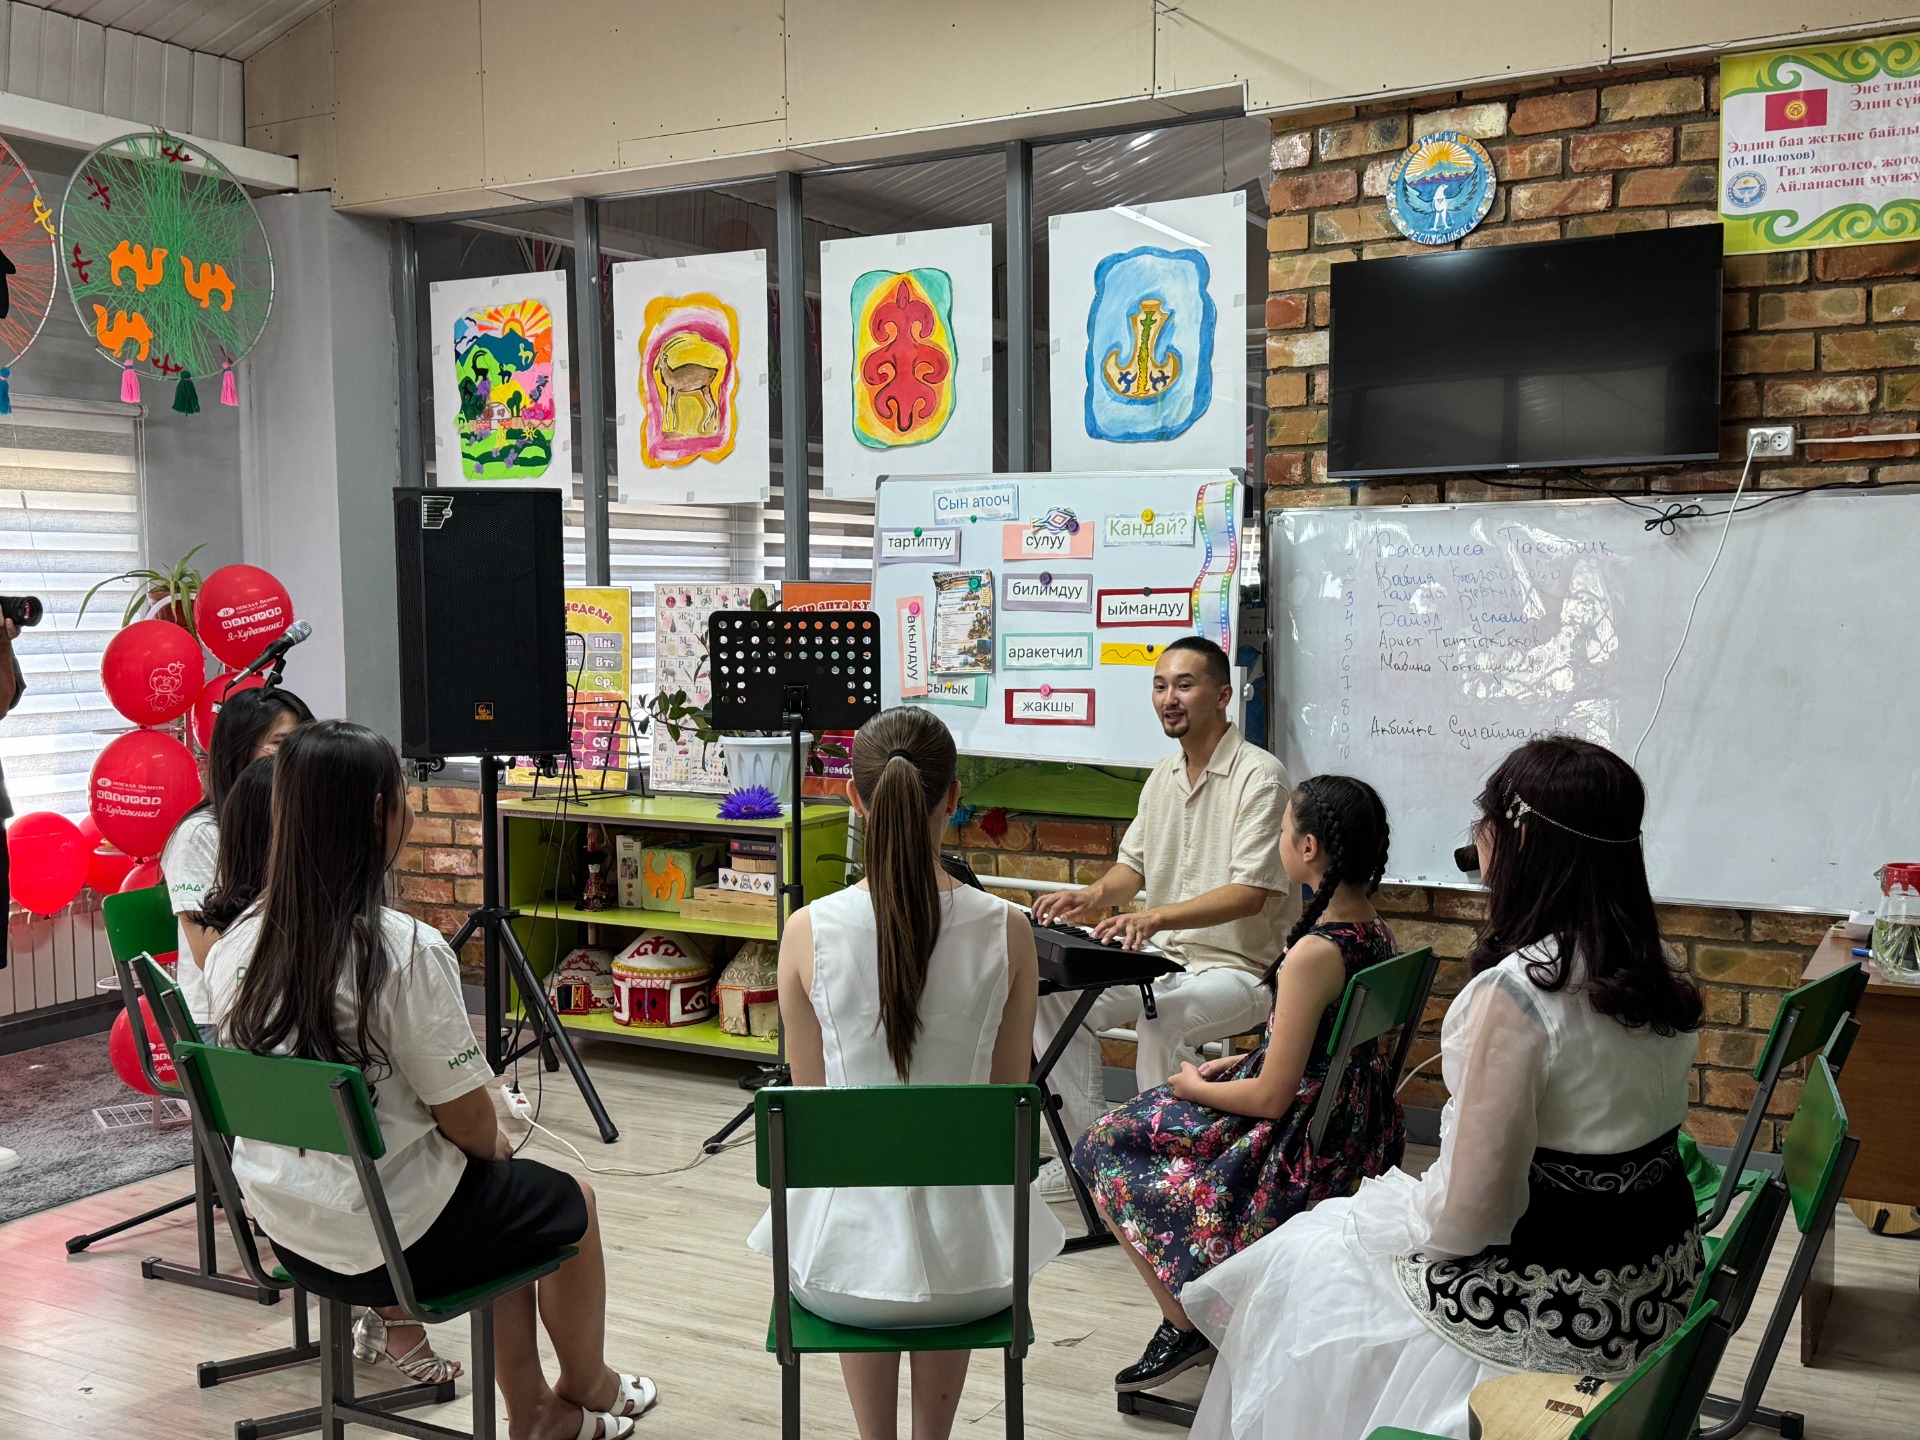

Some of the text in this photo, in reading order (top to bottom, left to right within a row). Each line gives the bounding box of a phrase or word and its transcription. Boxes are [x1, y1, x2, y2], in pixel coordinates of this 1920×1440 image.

[1850, 83, 1880, 96] Эне
[1849, 98, 1892, 112] Элин
[1727, 139, 1774, 154] Элдин
[1779, 135, 1804, 148] баа
[1808, 131, 1864, 145] жеткис
[1727, 149, 1815, 169] (М. Шолохов)
[1775, 165, 1805, 178] Тил
[1810, 160, 1877, 174] жоголсо,
[937, 494, 1011, 511] Сын атооч
[1109, 517, 1188, 539] Кандай?
[888, 536, 952, 551] тартиптуу
[1025, 535, 1066, 550] сулуу
[697, 587, 703, 596] В
[1012, 582, 1083, 599] билимдуу
[1344, 591, 1354, 607] 3
[818, 600, 849, 611] апта
[1107, 600, 1184, 617] ыймандуу
[1345, 609, 1354, 626] 4
[594, 637, 616, 649] Пн.
[907, 615, 918, 681] акылдуу
[1343, 634, 1354, 651] 5
[595, 657, 615, 668] Вт.
[1007, 647, 1083, 662] аракетчил
[1341, 654, 1351, 671] 6
[1380, 650, 1432, 672] Мадина
[594, 675, 614, 688] Ср.
[1340, 675, 1353, 692] 7
[1022, 701, 1074, 713] жакшы
[1341, 698, 1350, 716] 8
[1341, 722, 1350, 743] 9
[1340, 745, 1351, 760] 10
